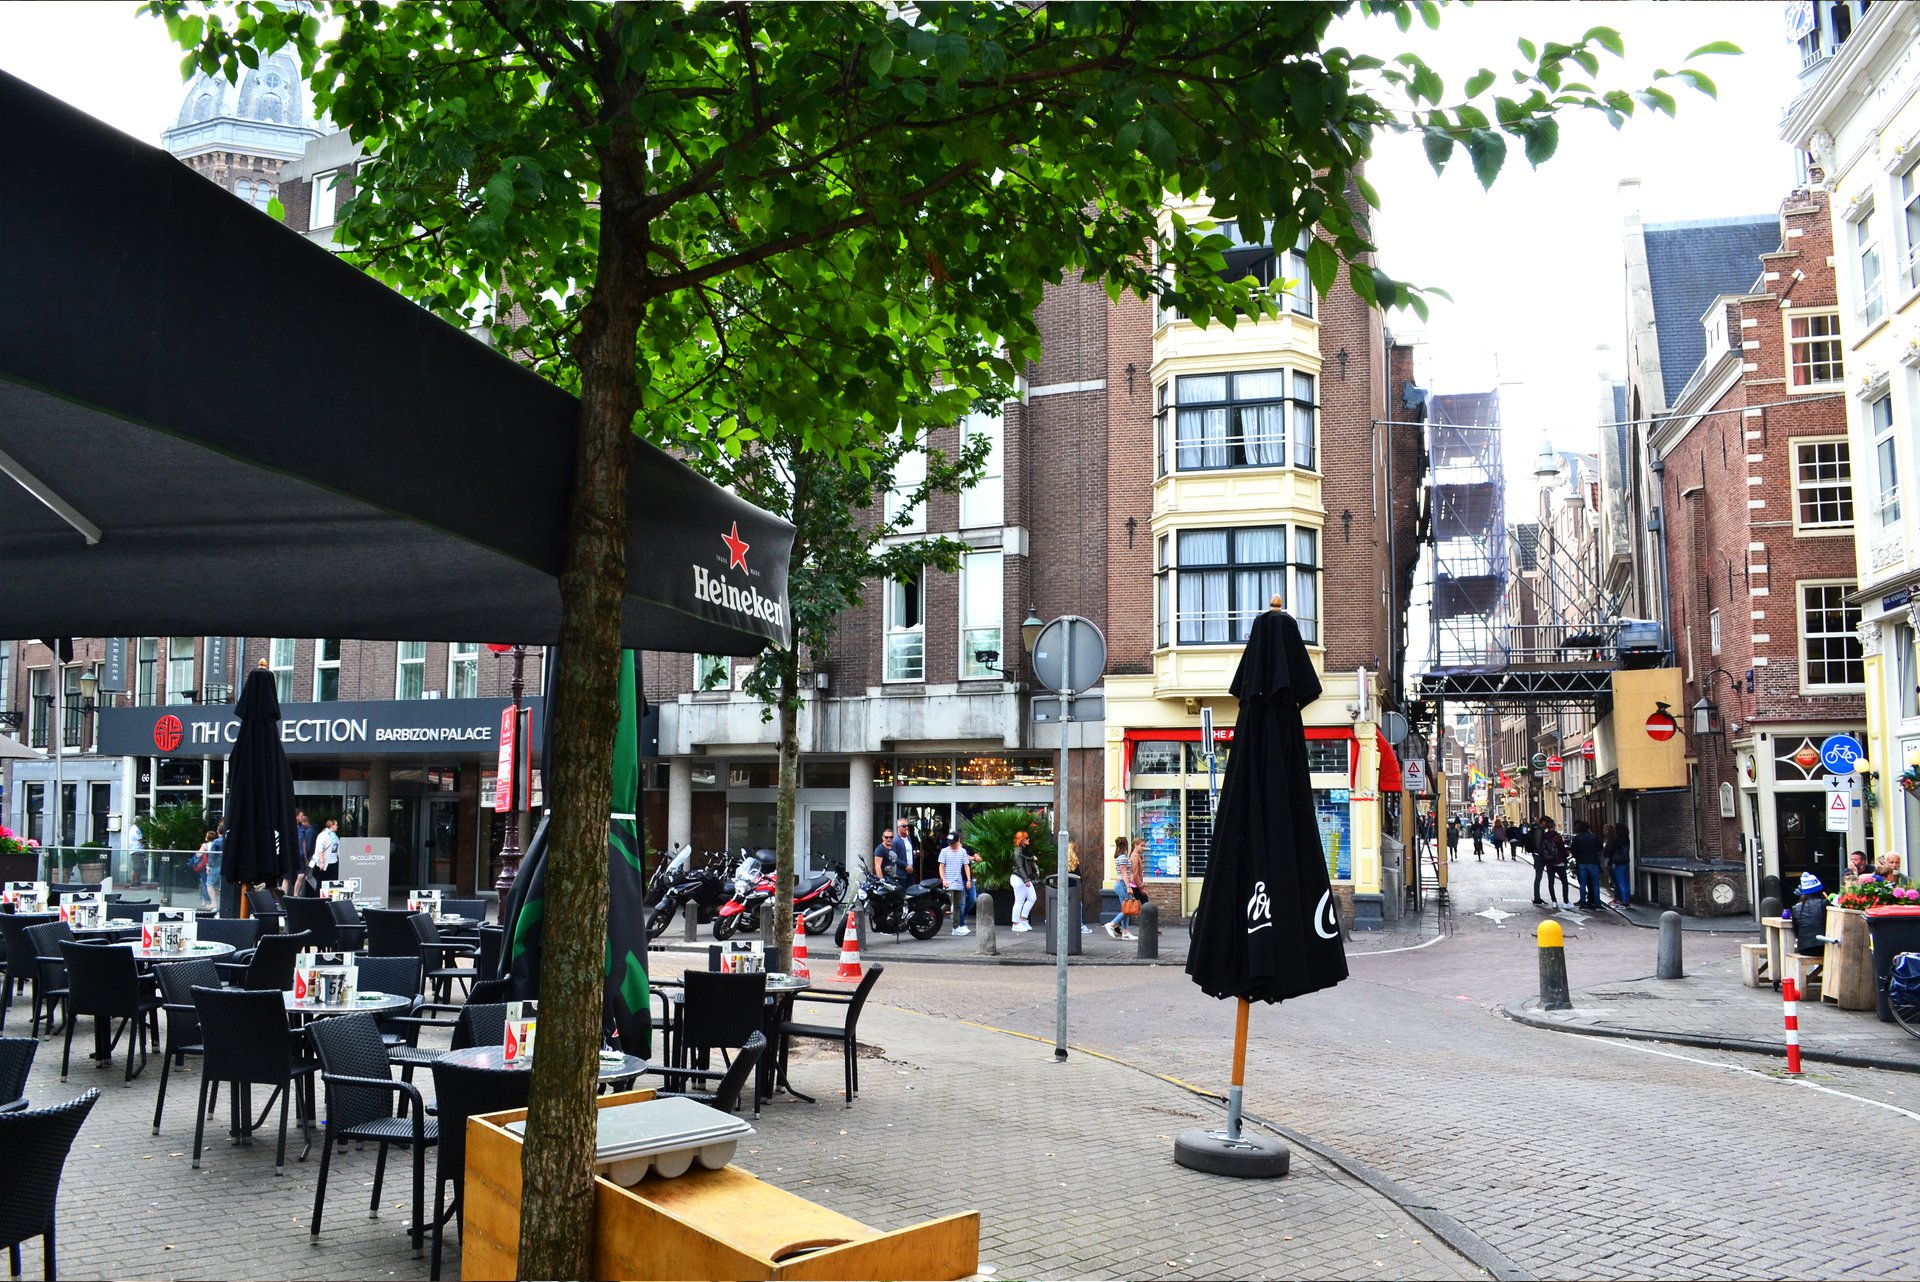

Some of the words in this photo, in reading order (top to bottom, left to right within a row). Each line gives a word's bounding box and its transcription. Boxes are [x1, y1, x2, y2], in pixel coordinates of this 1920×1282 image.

[692, 564, 784, 627] Heineken
[224, 718, 368, 744] CECTION
[375, 727, 439, 741] BARBIZON
[440, 726, 492, 741] PALACE
[1213, 730, 1226, 739] HE
[141, 773, 150, 783] 66
[166, 933, 179, 945] 53
